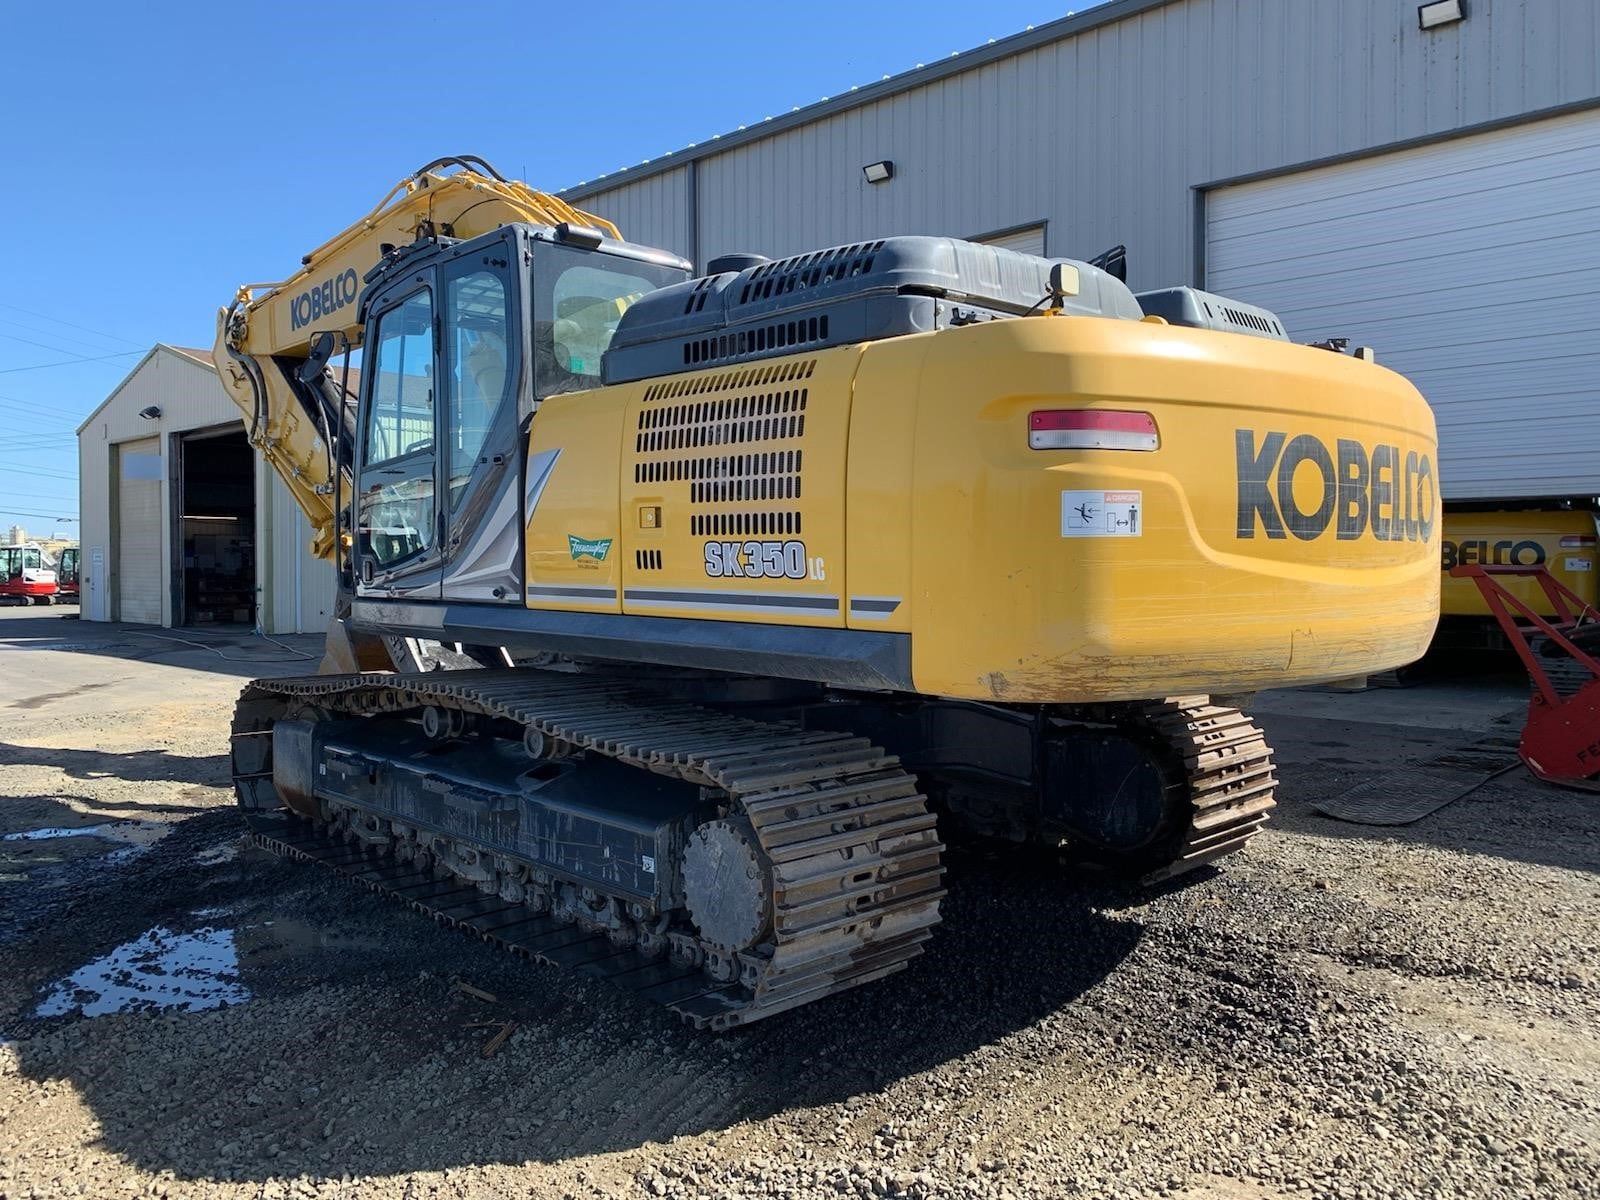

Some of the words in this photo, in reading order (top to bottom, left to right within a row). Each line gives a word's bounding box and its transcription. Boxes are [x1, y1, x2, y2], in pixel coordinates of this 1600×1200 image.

[290, 267, 358, 332] KOBELCO
[1235, 428, 1434, 543] KOBELCO
[704, 540, 807, 579] SK350
[1576, 740, 1600, 764] FE
